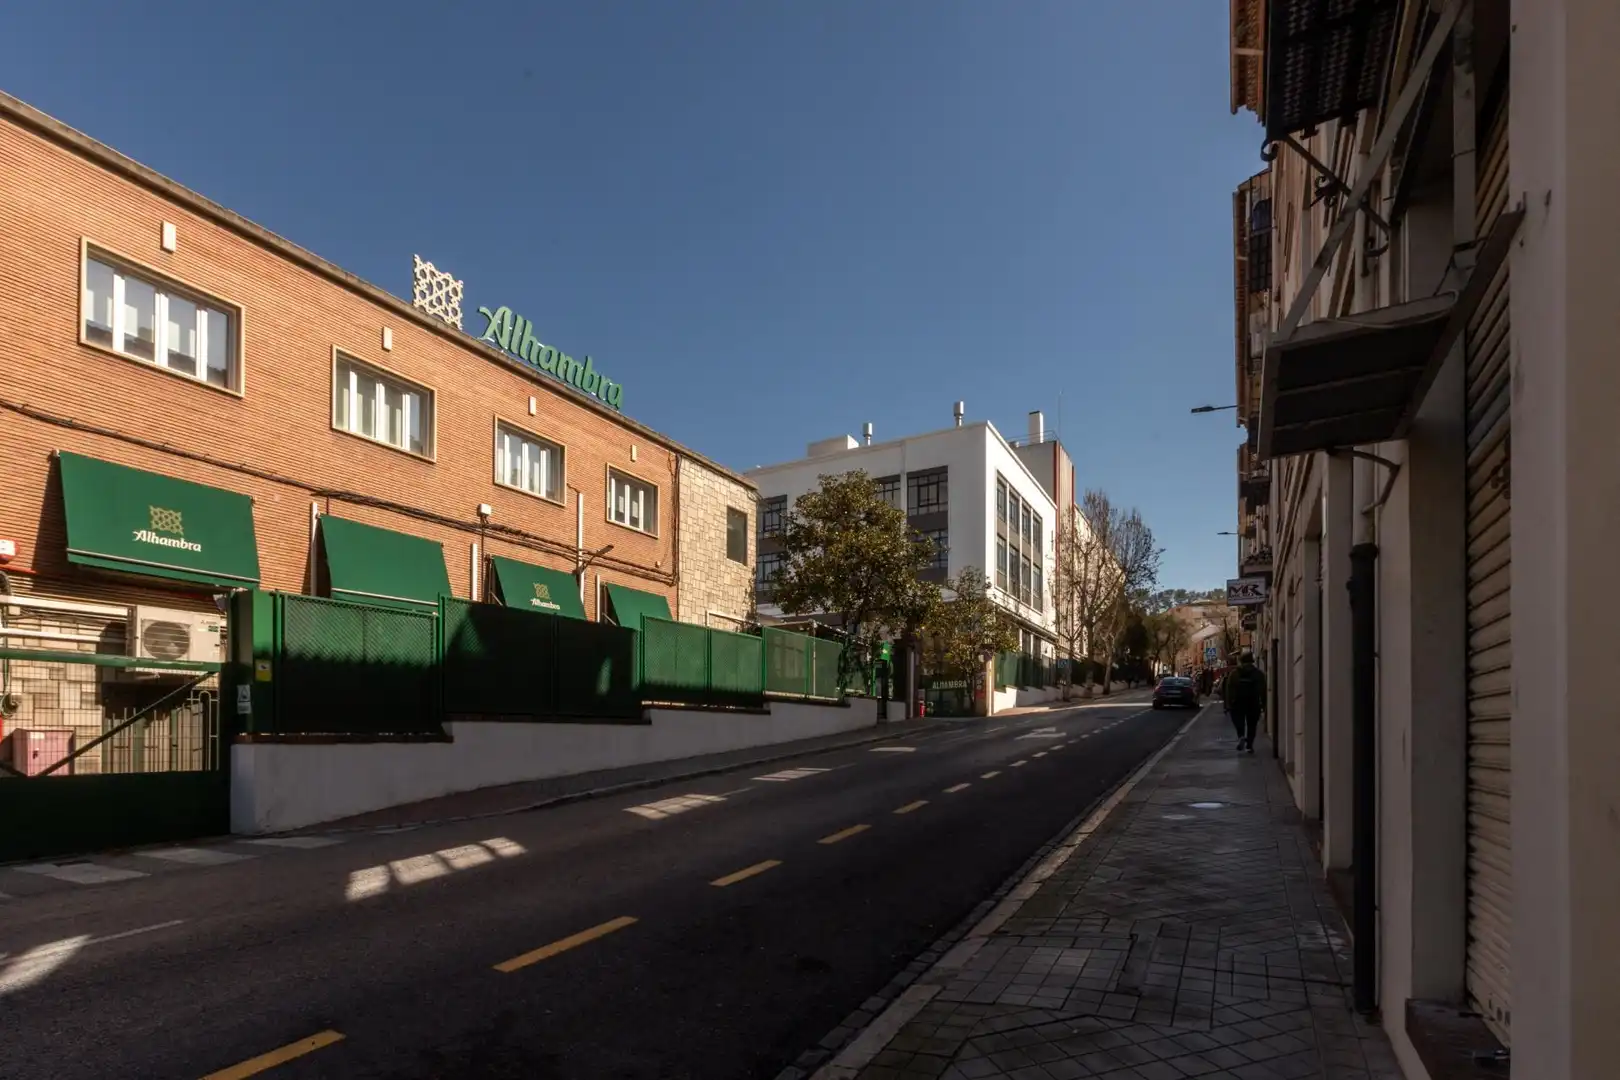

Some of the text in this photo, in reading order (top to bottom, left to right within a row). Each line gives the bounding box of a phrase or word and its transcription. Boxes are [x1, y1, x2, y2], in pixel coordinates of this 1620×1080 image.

[477, 305, 623, 409] Alhambra
[132, 530, 202, 552] Alhambra
[530, 598, 561, 610] Alhambra
[932, 680, 968, 690] ALHAMBRA
